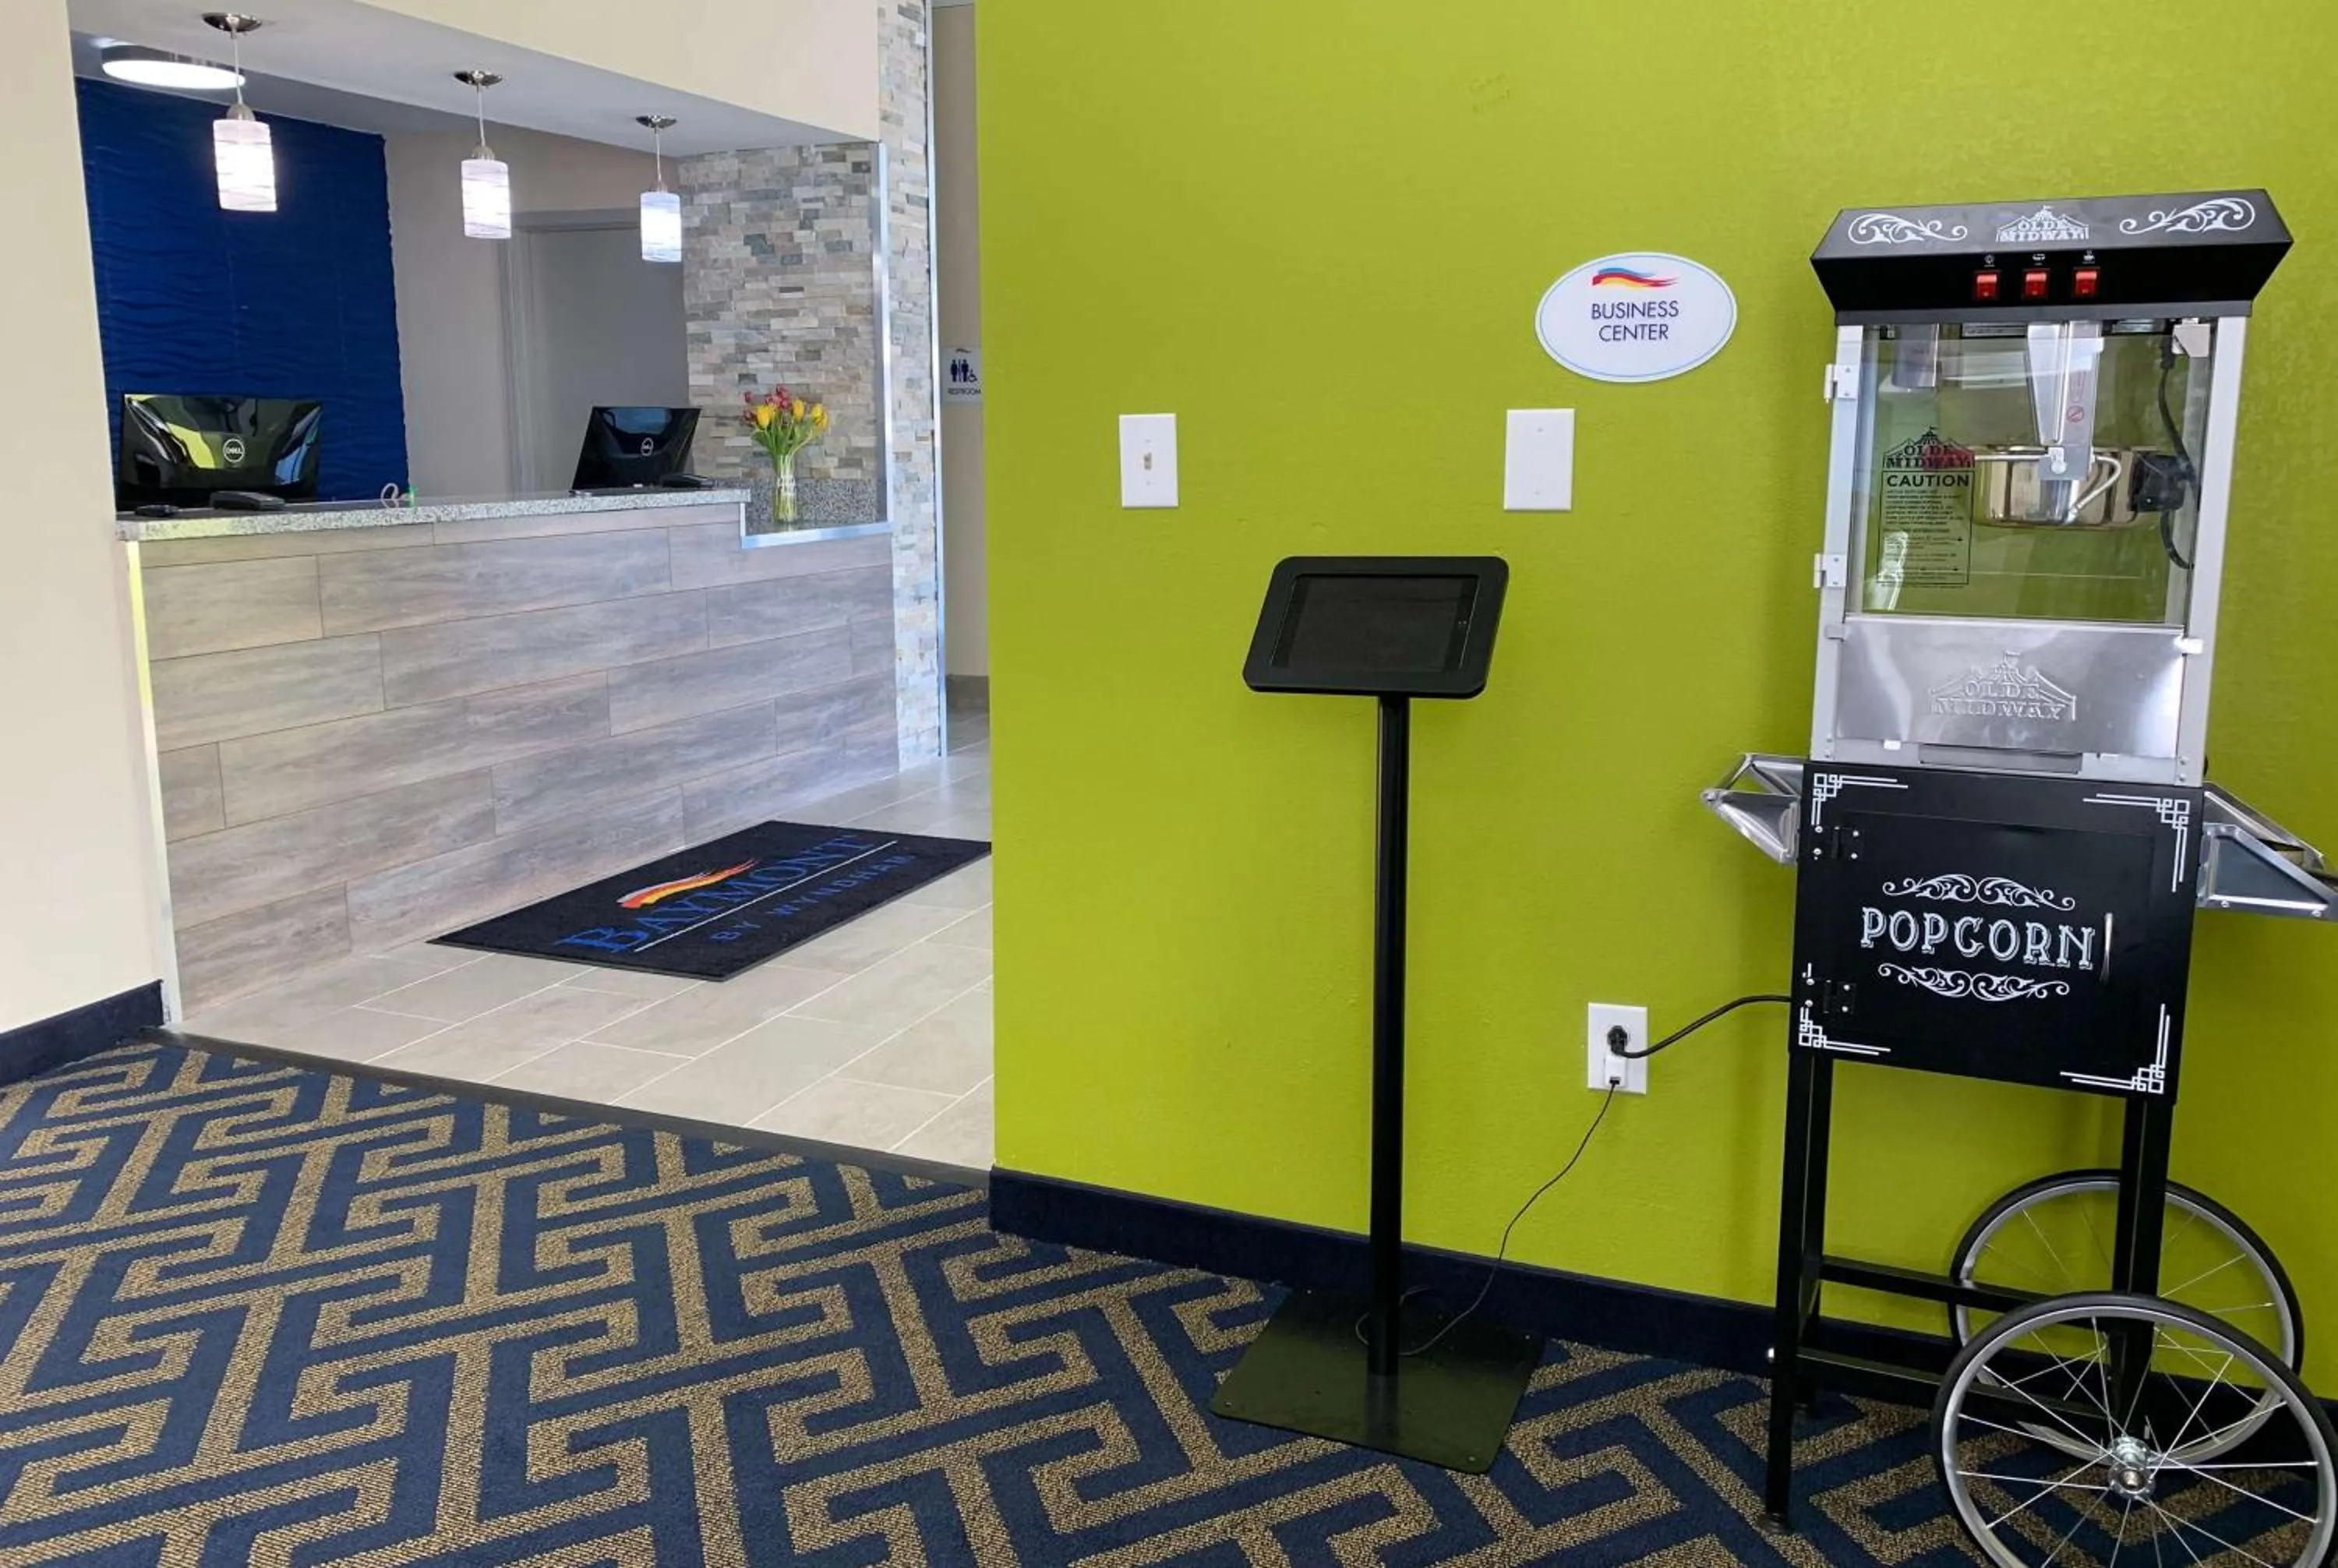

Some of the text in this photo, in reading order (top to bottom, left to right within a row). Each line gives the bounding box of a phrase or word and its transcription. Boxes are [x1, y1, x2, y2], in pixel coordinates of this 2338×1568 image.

[1591, 300, 1679, 320] BUSINESS
[1598, 323, 1669, 342] CENTER
[1886, 474, 1970, 487] CAUTION
[1964, 680, 2040, 700] OLDE
[1930, 698, 2066, 719] MIDWAY
[554, 835, 875, 954] BAYMONT
[709, 856, 916, 943] BY WYNDHAM
[1859, 906, 2096, 970] POPCORN
